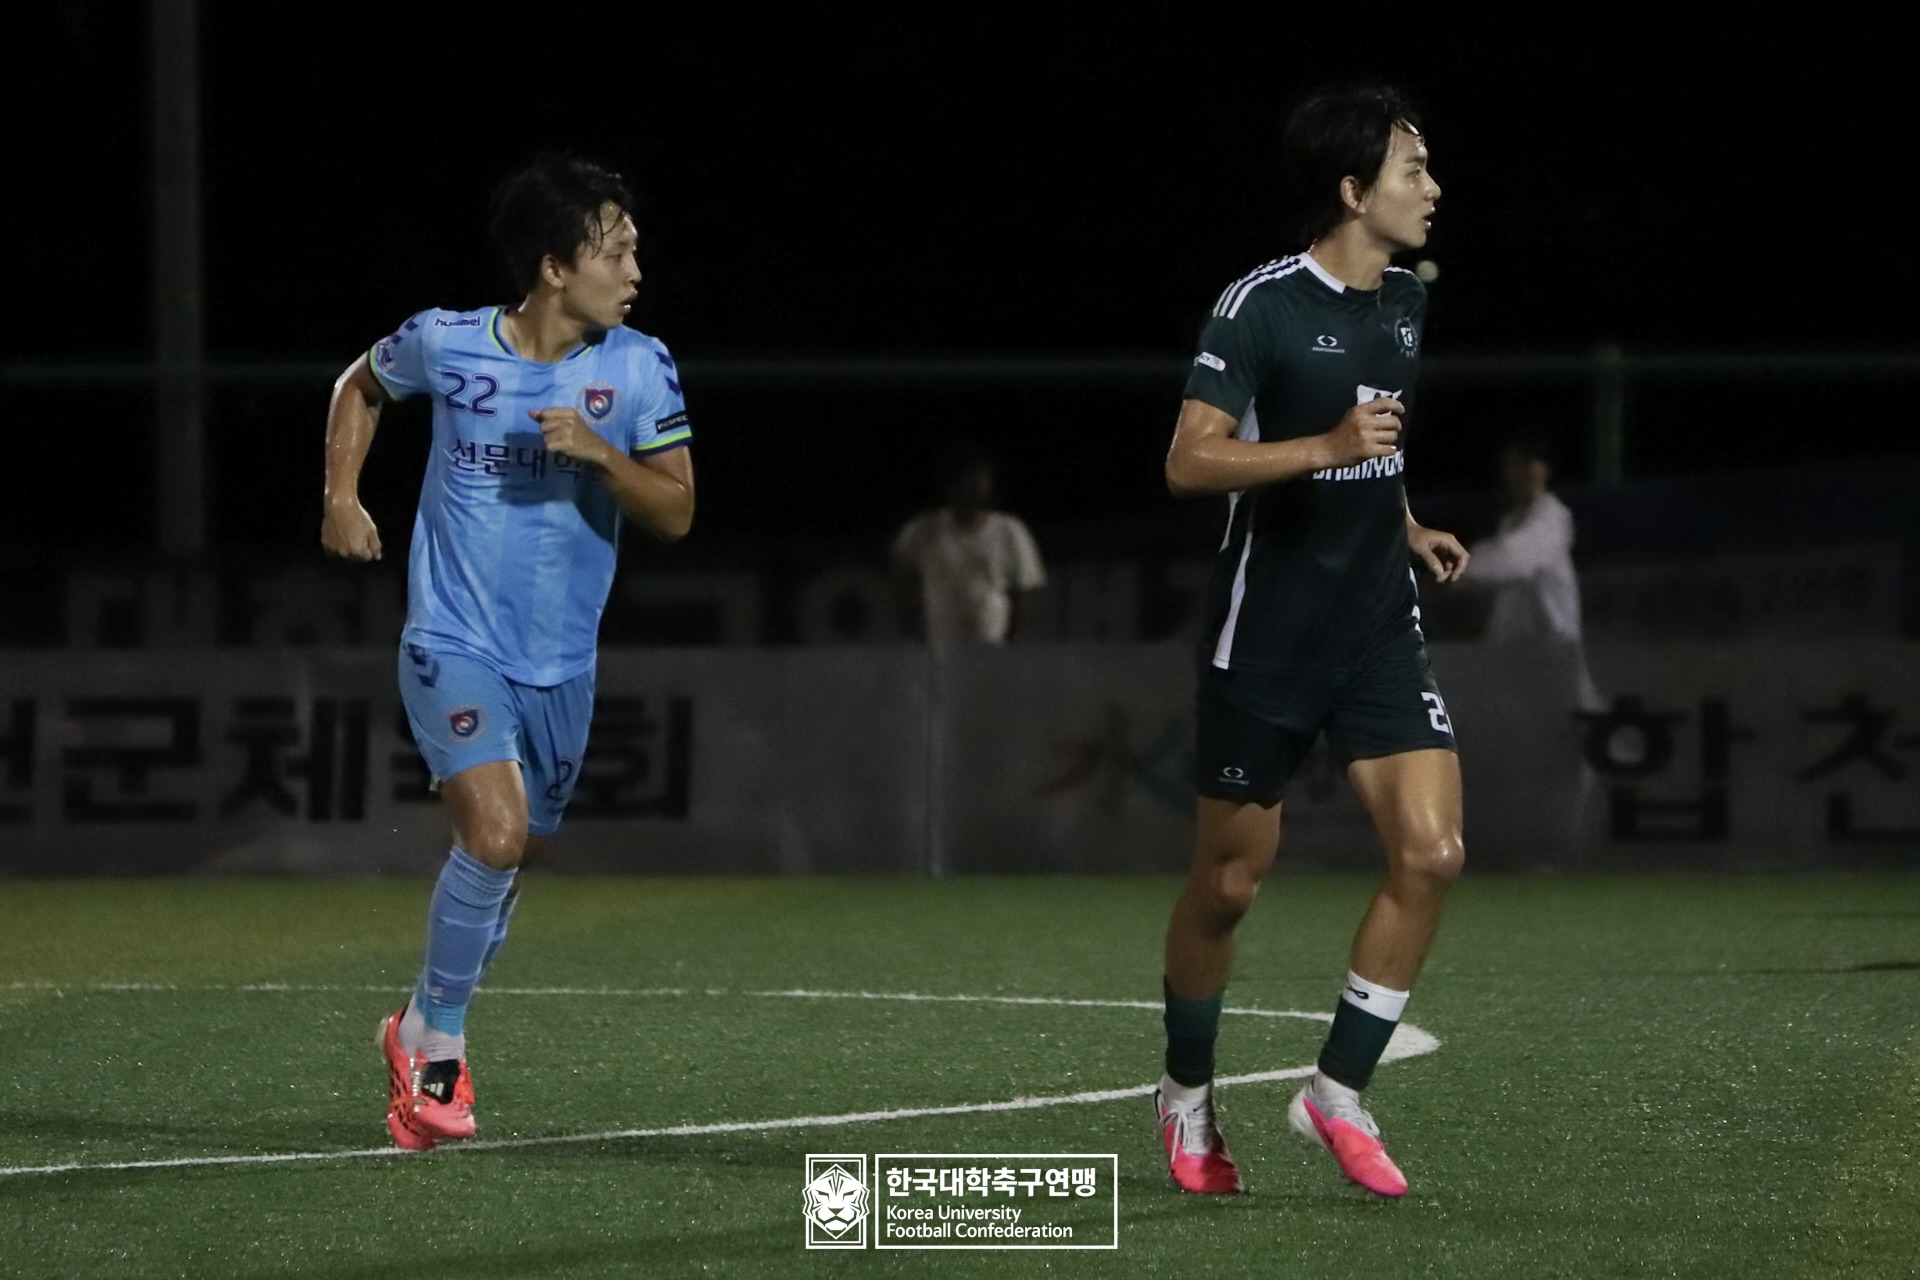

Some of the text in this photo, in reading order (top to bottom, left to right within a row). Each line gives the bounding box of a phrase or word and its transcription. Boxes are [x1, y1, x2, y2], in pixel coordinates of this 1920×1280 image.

[435, 316, 481, 327] hummel
[441, 371, 499, 416] 22
[1420, 691, 1455, 738] 2
